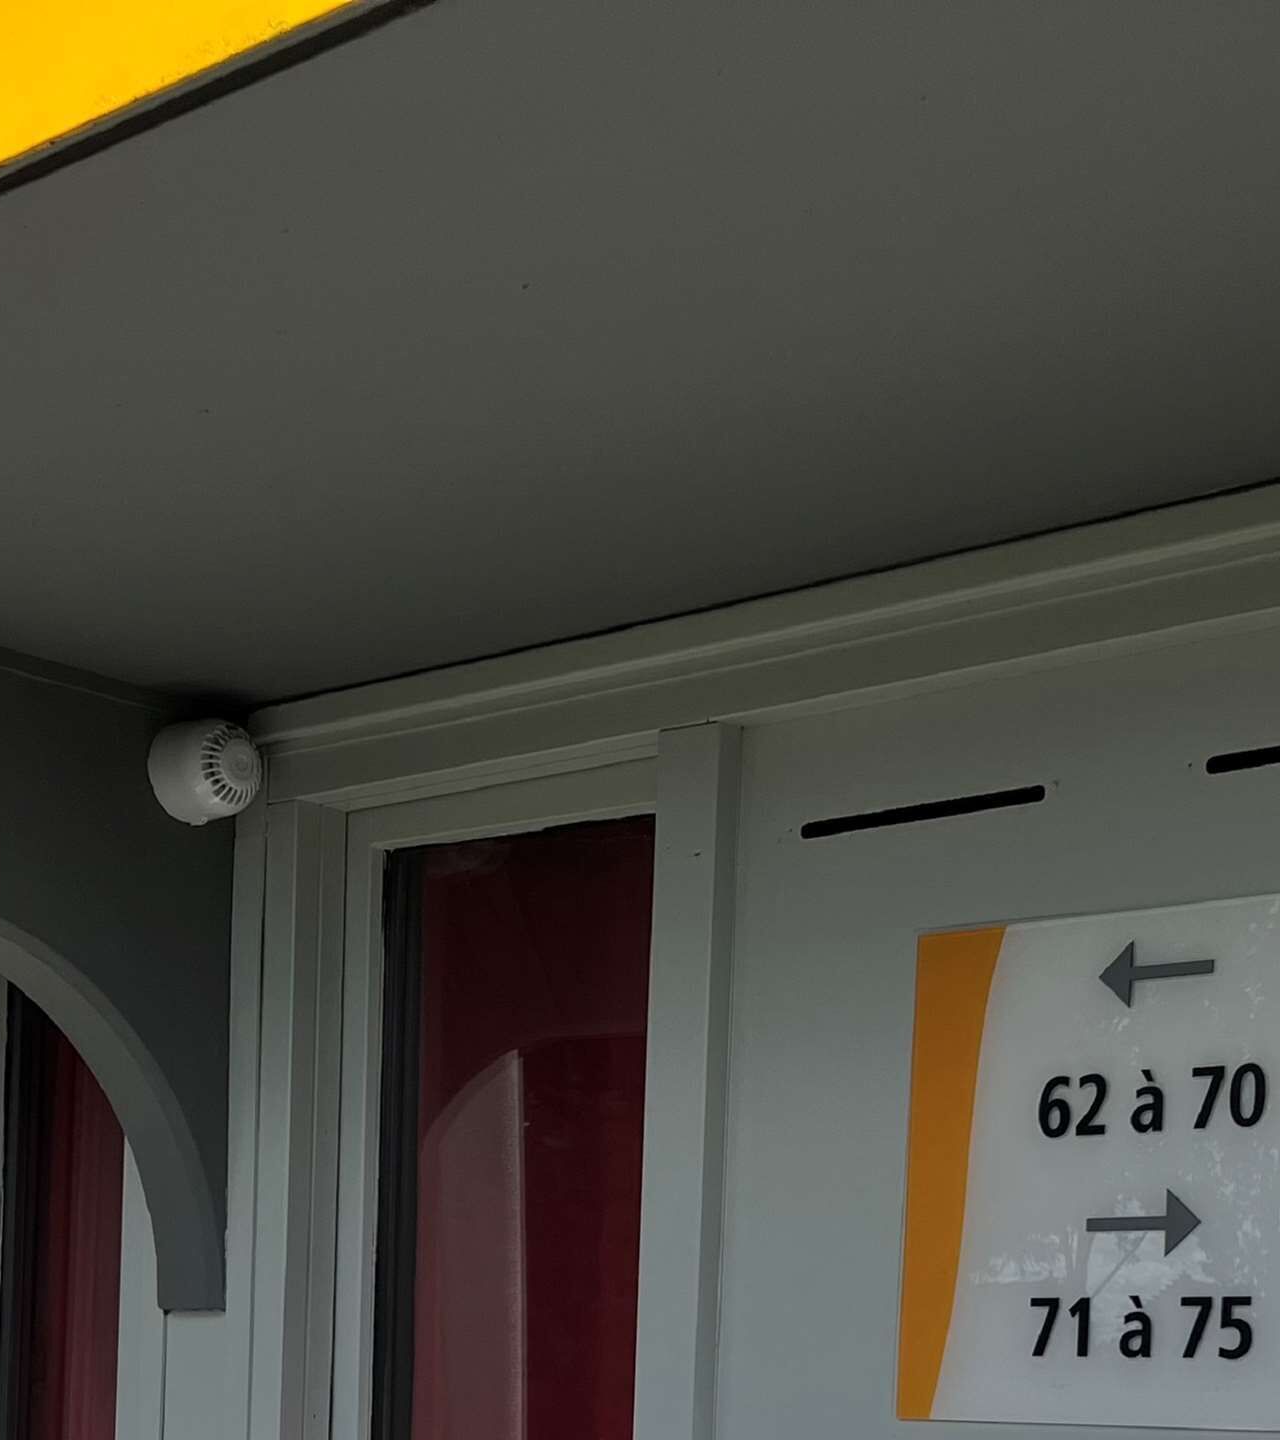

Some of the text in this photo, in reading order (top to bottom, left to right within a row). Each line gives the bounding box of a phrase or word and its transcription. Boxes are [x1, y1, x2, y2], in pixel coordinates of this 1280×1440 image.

[1038, 1063, 1266, 1138] 62 à 70
[1030, 1295, 1253, 1359] 71 à 75
